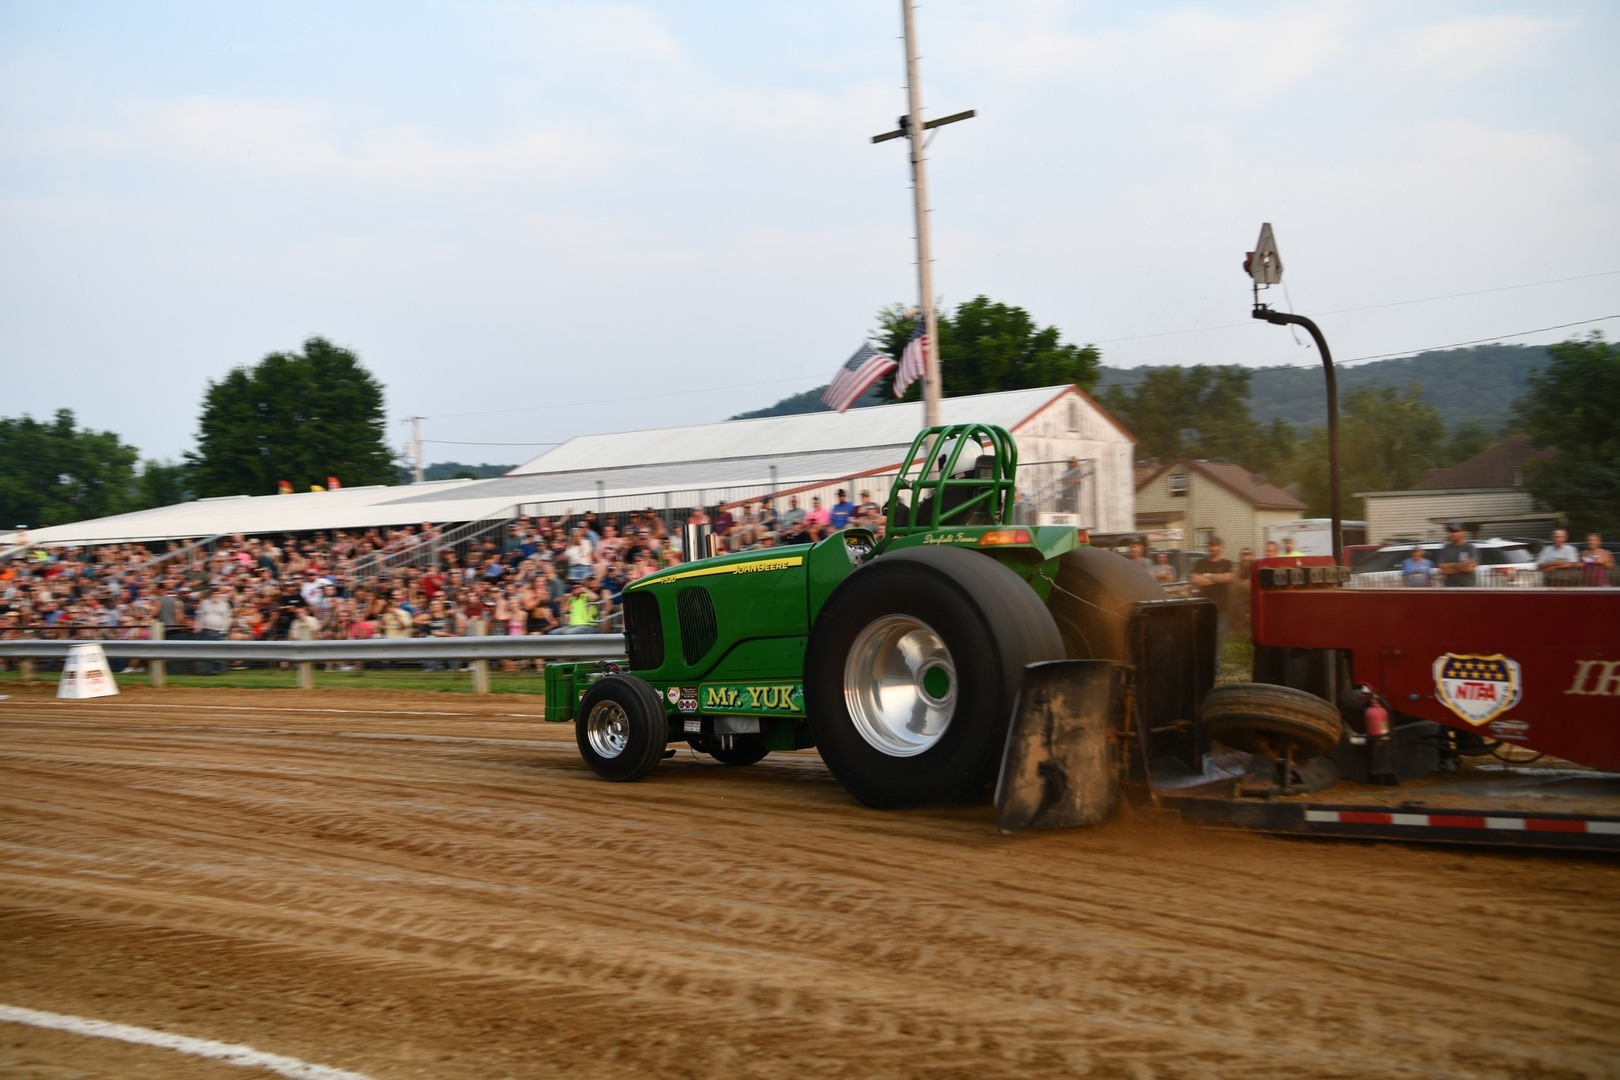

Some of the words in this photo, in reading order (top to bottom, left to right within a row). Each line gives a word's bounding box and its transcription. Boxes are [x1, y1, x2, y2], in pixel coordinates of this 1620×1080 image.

[733, 565, 757, 575] JOHN
[758, 562, 788, 573] DEERE
[707, 687, 742, 706] Mr.
[747, 686, 800, 711] YUK
[1455, 682, 1498, 702] NTPA
